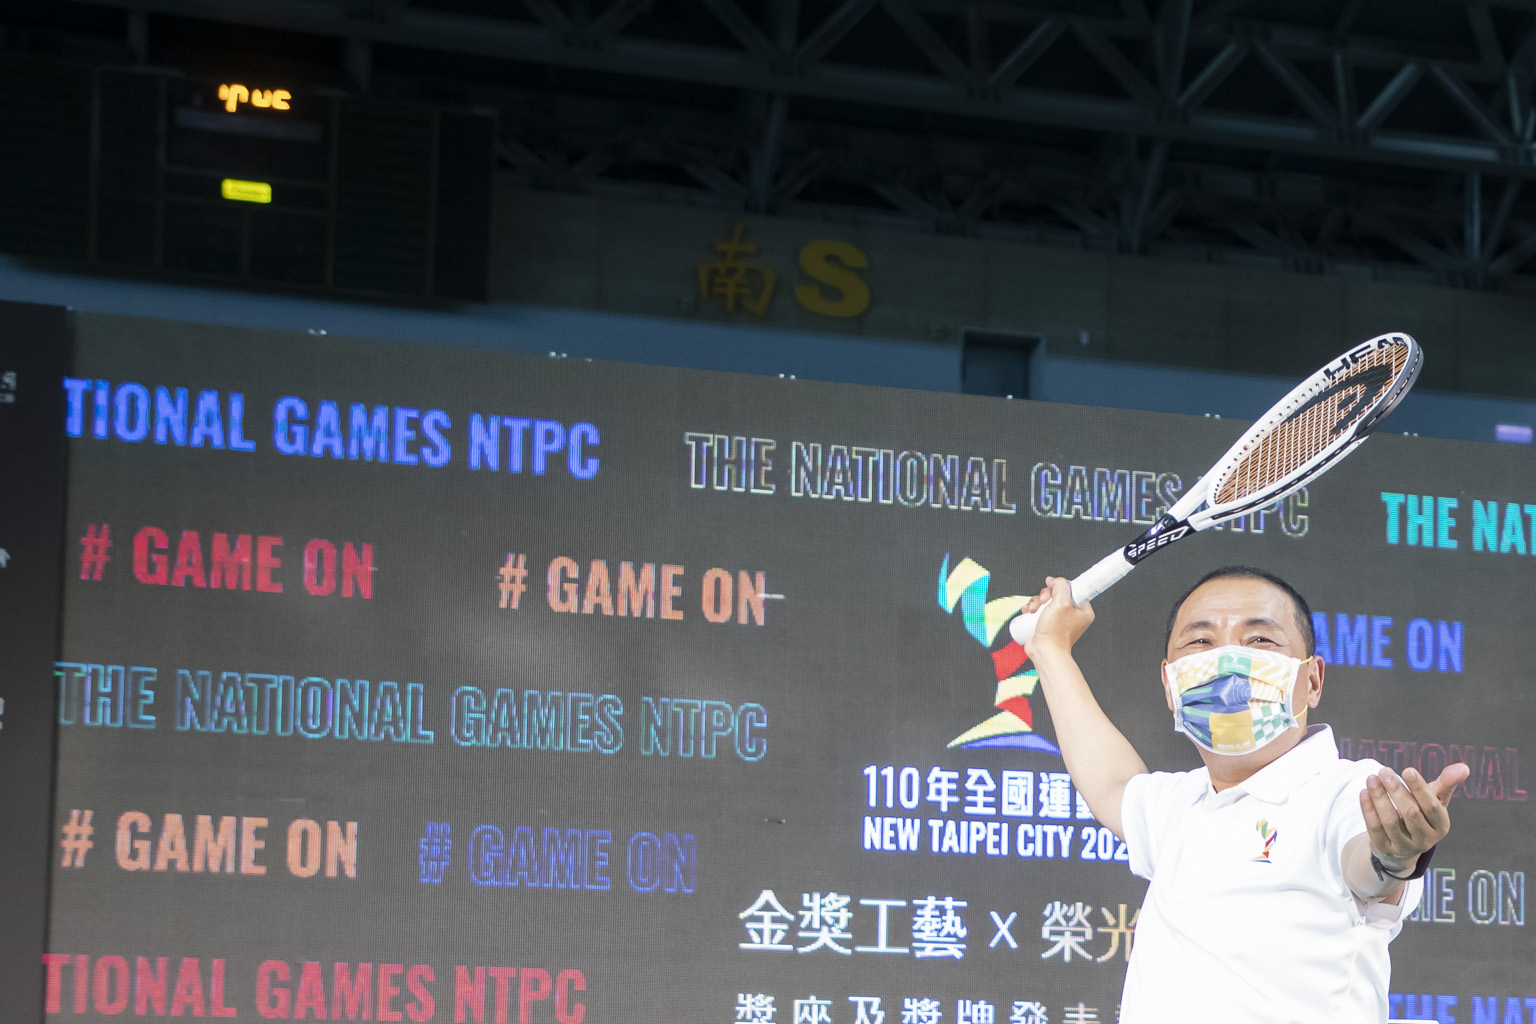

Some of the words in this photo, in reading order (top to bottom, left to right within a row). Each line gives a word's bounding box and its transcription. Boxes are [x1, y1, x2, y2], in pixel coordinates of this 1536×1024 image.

[795, 239, 870, 317] S
[62, 377, 256, 452] TIONAL
[273, 396, 452, 467] GAMES
[468, 413, 600, 479] NTPC
[685, 432, 776, 494] THE
[791, 442, 1016, 514] NATIONAL
[1031, 461, 1181, 525] GAMES
[1127, 525, 1190, 558] SPEED
[1381, 491, 1458, 549] THE
[133, 526, 284, 593] GAME
[304, 539, 374, 600] ON
[547, 556, 685, 620] GAME
[702, 567, 766, 626] ON
[1311, 612, 1391, 670] AME
[1407, 620, 1464, 674] ON
[54, 661, 157, 729] THE
[176, 669, 434, 744] NATIONAL
[451, 686, 623, 755] GAMES
[640, 696, 767, 762] NTPC
[115, 811, 267, 876] GAME
[286, 820, 358, 879] ON
[468, 824, 611, 890] GAME
[627, 831, 697, 894] ON
[863, 815, 921, 852] NEW
[927, 818, 1009, 857] TAIPEI
[1016, 823, 1075, 860] CITY
[738, 889, 970, 960] 金獎工藝
[1467, 869, 1525, 926] ON
[42, 953, 237, 1017] TIONAL
[255, 959, 436, 1023] GAMES
